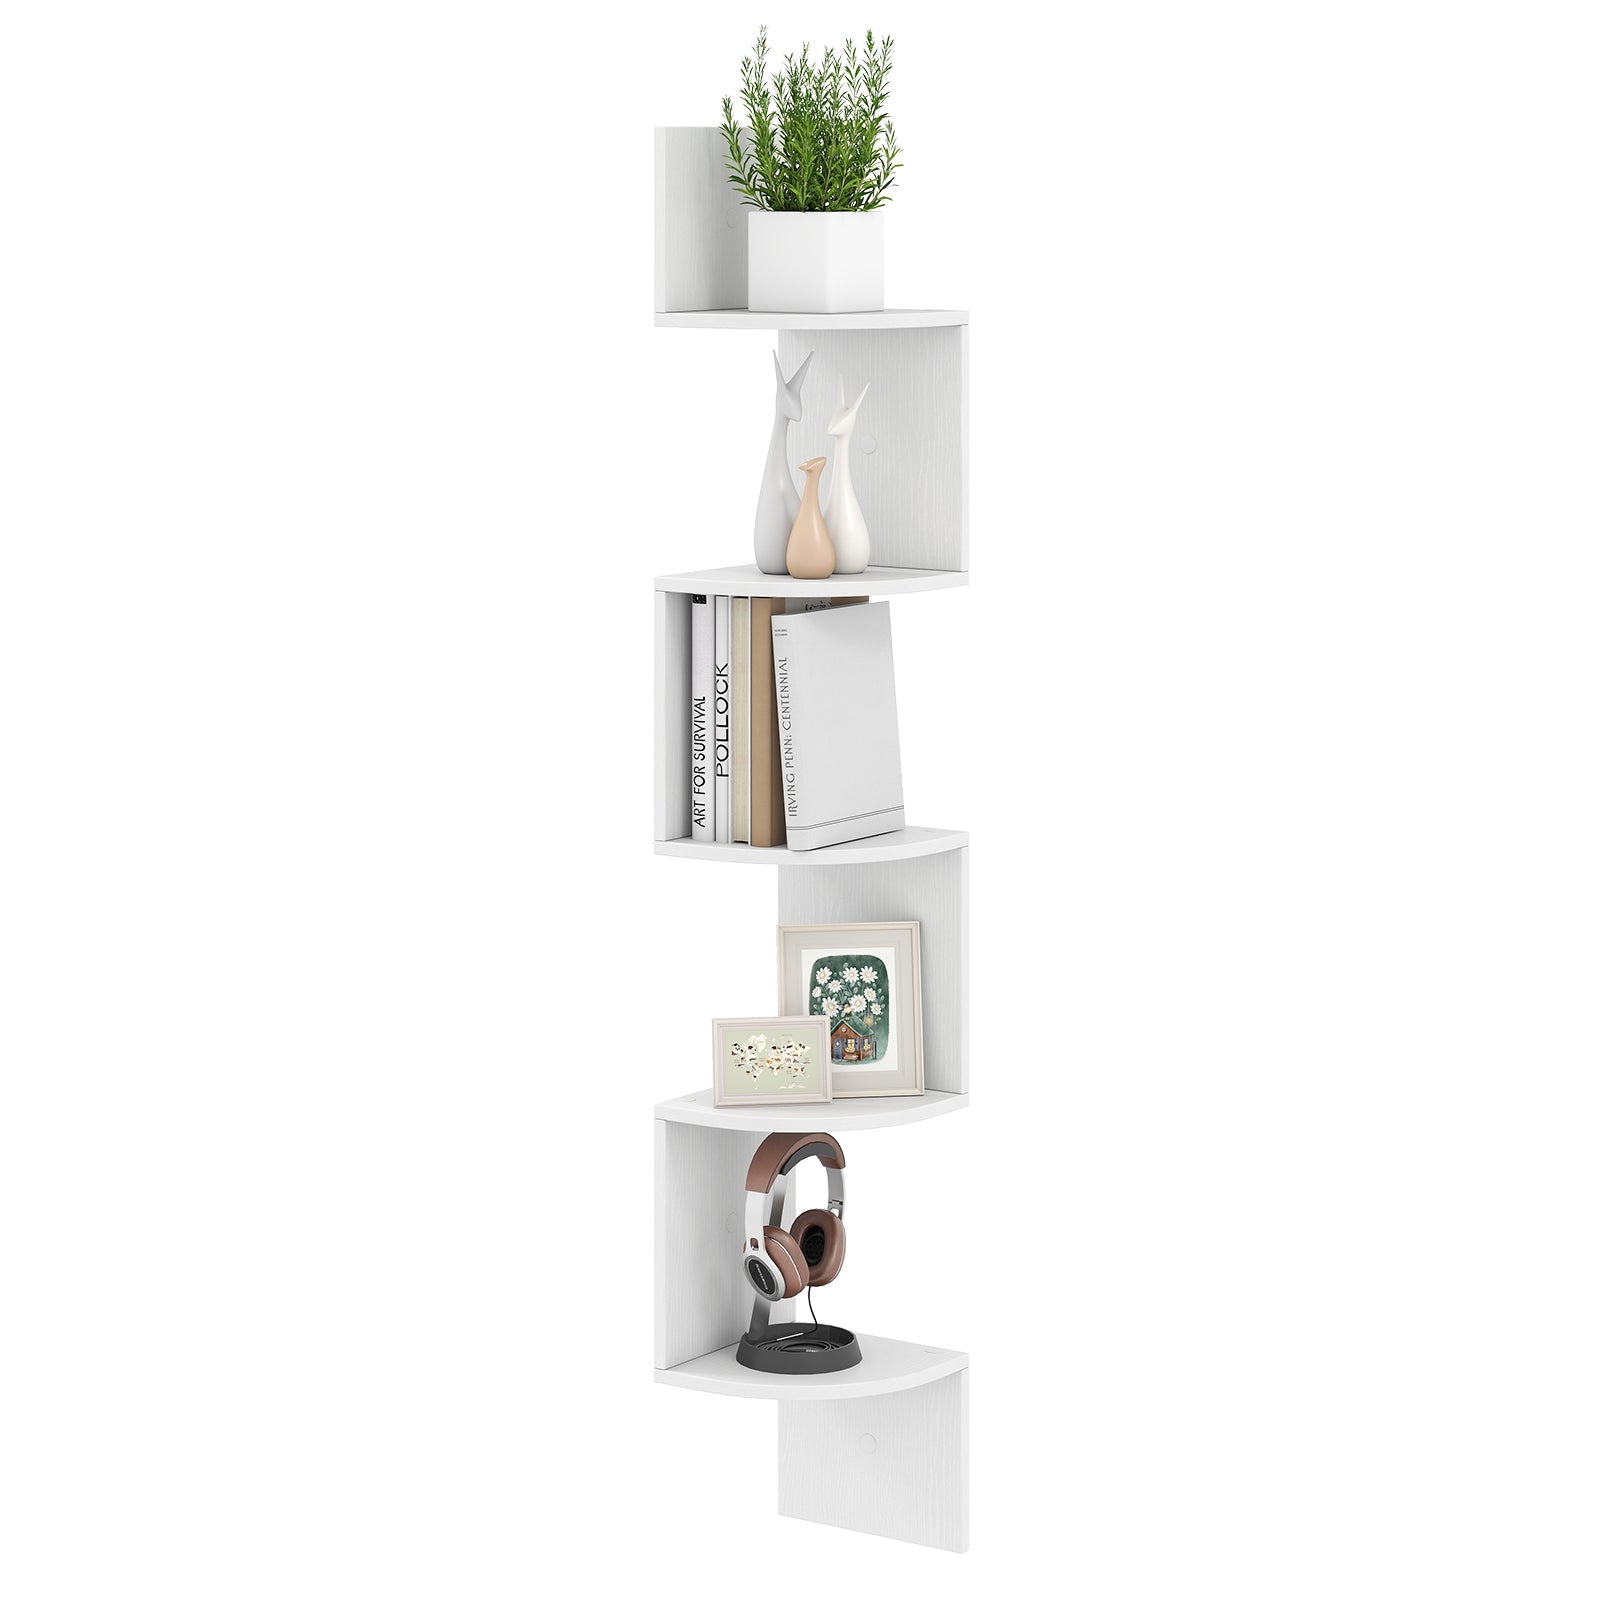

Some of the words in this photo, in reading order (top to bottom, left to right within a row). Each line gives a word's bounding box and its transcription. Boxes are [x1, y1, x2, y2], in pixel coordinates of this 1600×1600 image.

[778, 656, 791, 731] CENTENNIAL
[693, 696, 706, 761] SURVIVAL
[716, 662, 729, 777] POLLOCK
[783, 734, 794, 769] PENN:
[693, 766, 706, 795] FOR
[785, 772, 798, 817] IRVING
[693, 800, 706, 828] ART
